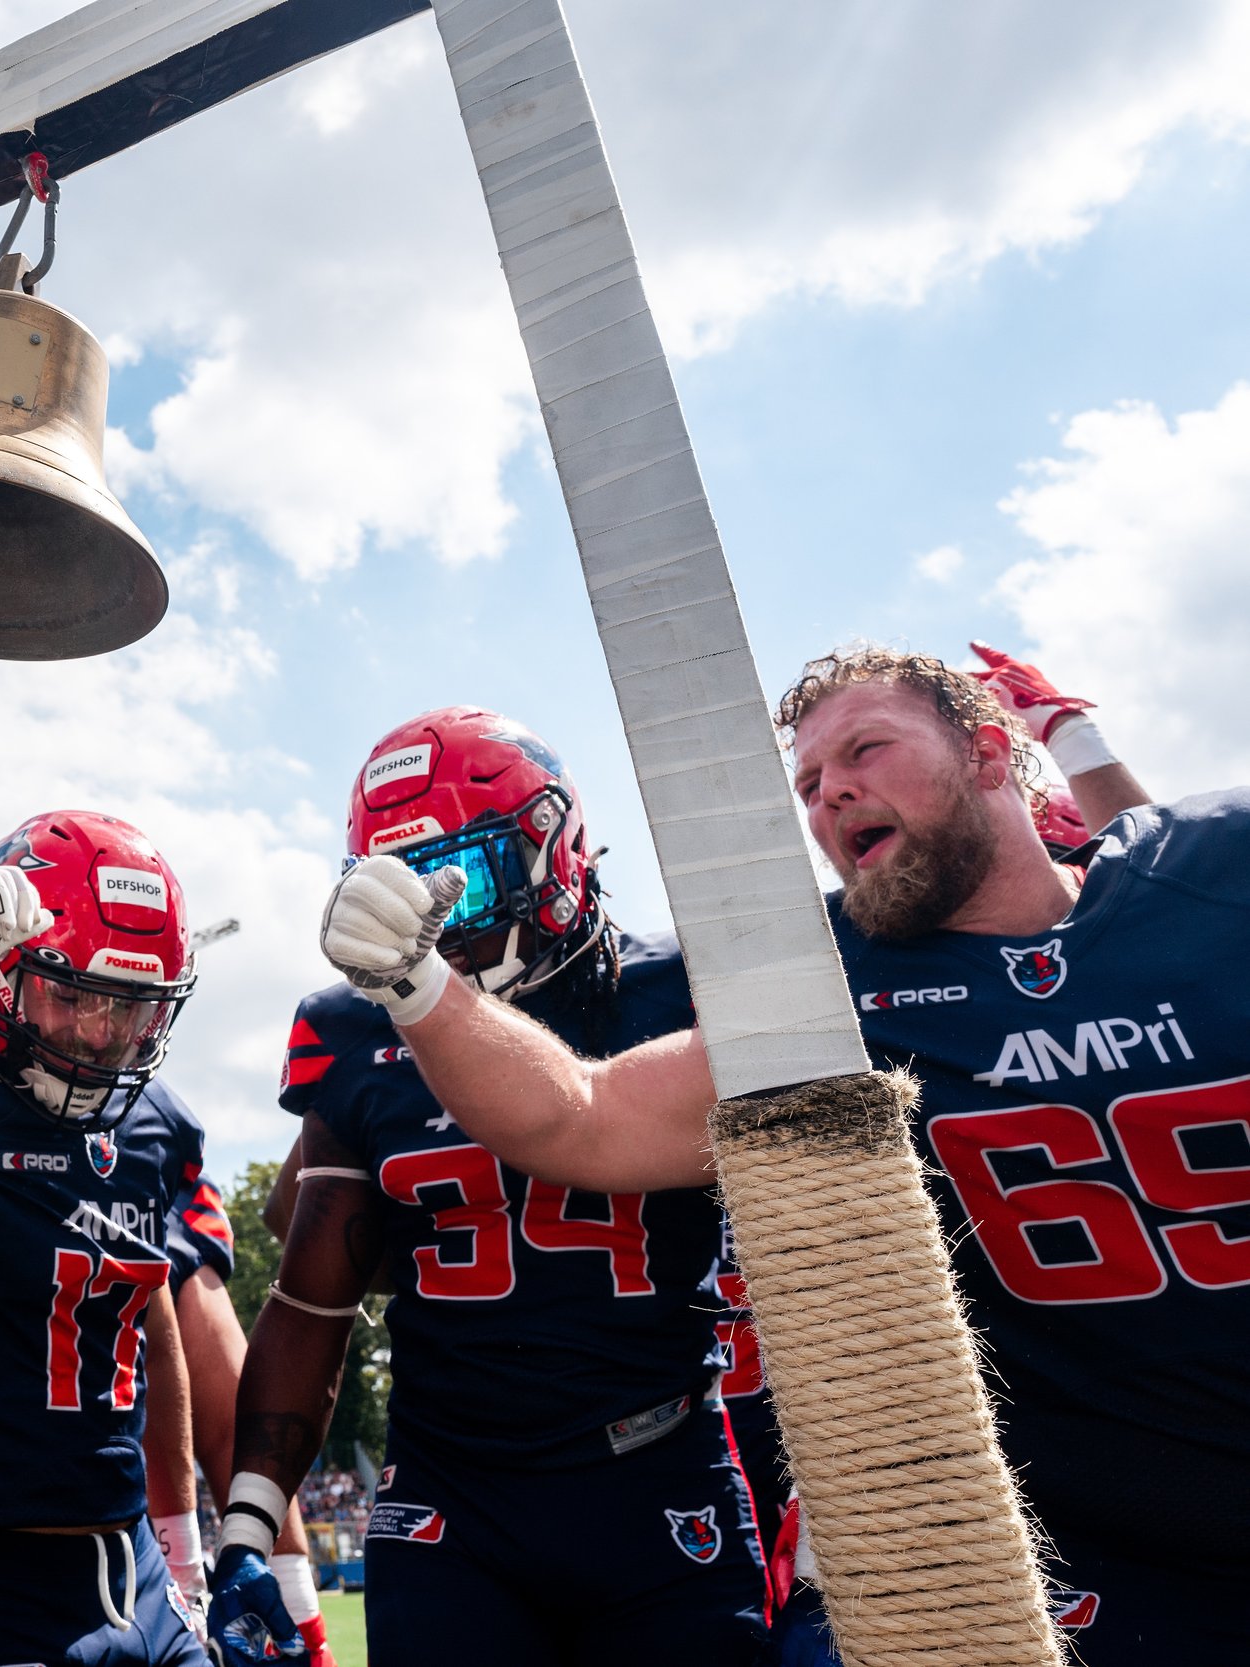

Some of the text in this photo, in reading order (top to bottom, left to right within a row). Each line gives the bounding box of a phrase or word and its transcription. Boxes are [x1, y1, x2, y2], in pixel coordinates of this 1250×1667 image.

[369, 755, 422, 780] DEFSHOP
[374, 823, 425, 846] FORELLE
[107, 879, 161, 896] DEFSHOP
[105, 956, 159, 973] FORELLE
[973, 1002, 1195, 1087] AMPri
[72, 1091, 95, 1100] iddell
[927, 1078, 1250, 1305] 69
[62, 1198, 156, 1245] AMPri
[380, 1143, 656, 1300] 34
[46, 1247, 172, 1411] 17
[370, 1523, 398, 1532] OOTBALL
